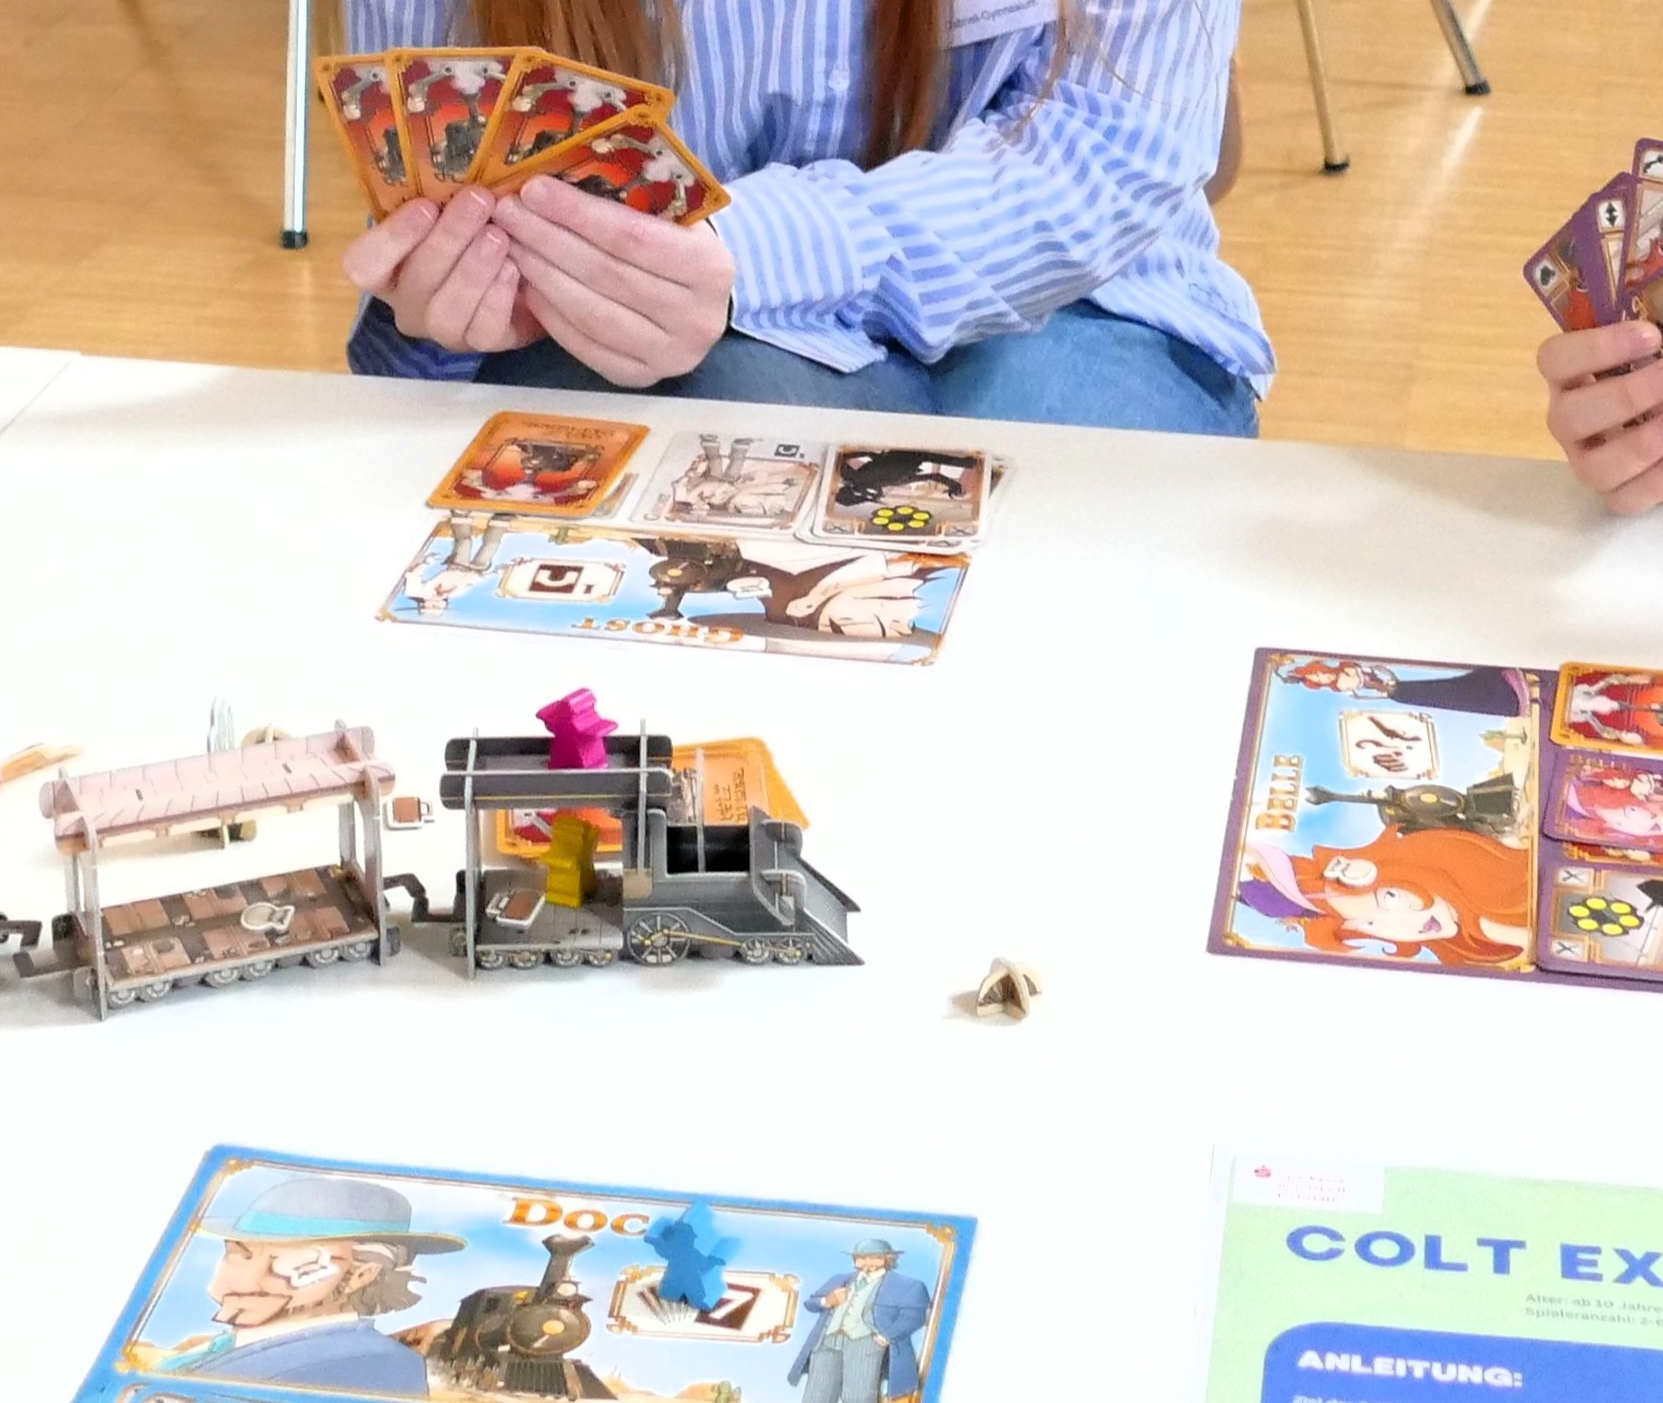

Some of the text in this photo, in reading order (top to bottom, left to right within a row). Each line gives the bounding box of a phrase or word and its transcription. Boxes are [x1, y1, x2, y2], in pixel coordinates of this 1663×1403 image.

[571, 617, 744, 644] GHOST
[1255, 754, 1304, 833] BELLE
[1286, 1224, 1527, 1276] COLT
[1525, 1293, 1568, 1305] Alter:
[1572, 1298, 1591, 1307] ab
[1596, 1299, 1614, 1309] 10
[1297, 1350, 1524, 1388] ANLEITUNG:
